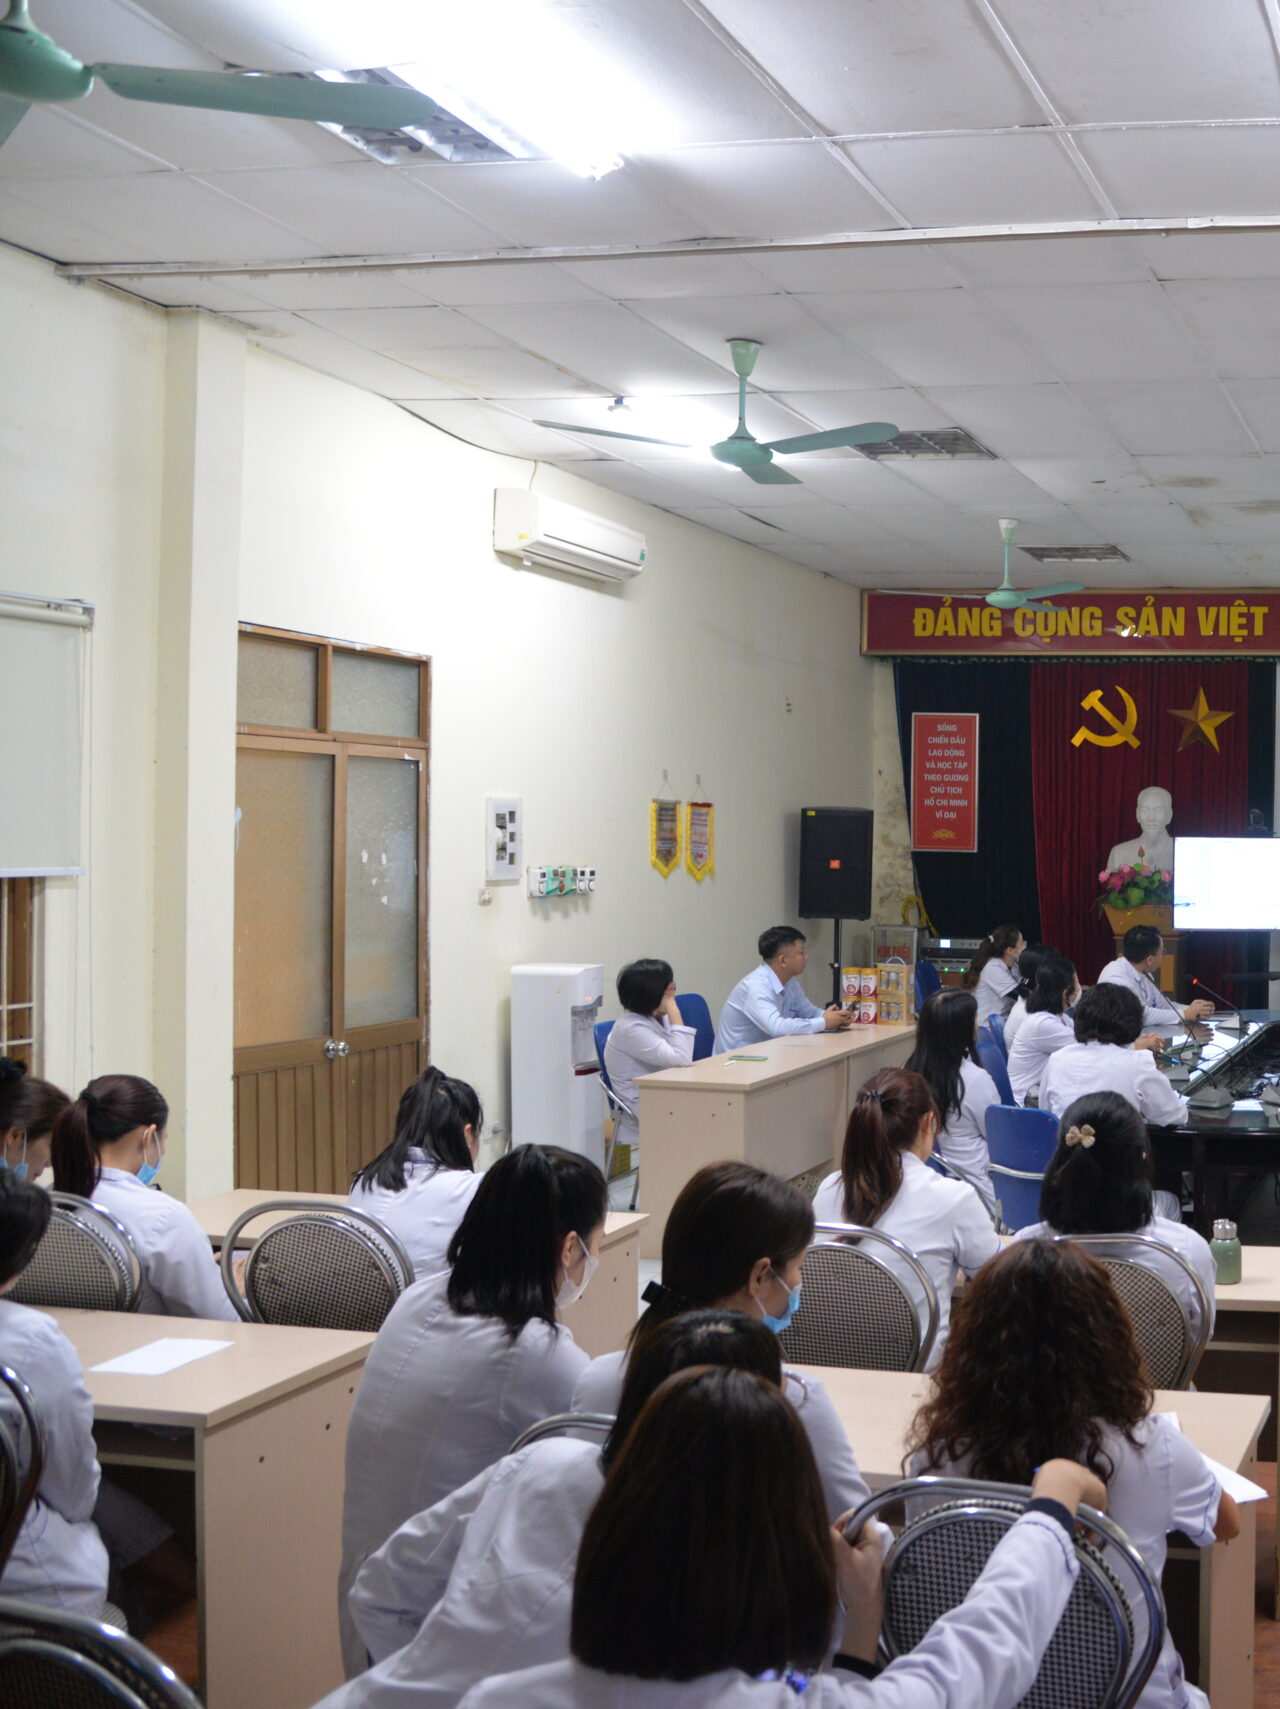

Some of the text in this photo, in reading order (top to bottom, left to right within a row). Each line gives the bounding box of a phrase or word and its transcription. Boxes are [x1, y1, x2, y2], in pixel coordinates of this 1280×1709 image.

[913, 597, 1003, 637] ĐẢNG
[1014, 600, 1103, 643] CỘNG
[1115, 595, 1185, 637] SẢN
[1197, 599, 1269, 642] VIỆT
[928, 749, 943, 757] LAO
[924, 773, 941, 781] THEO
